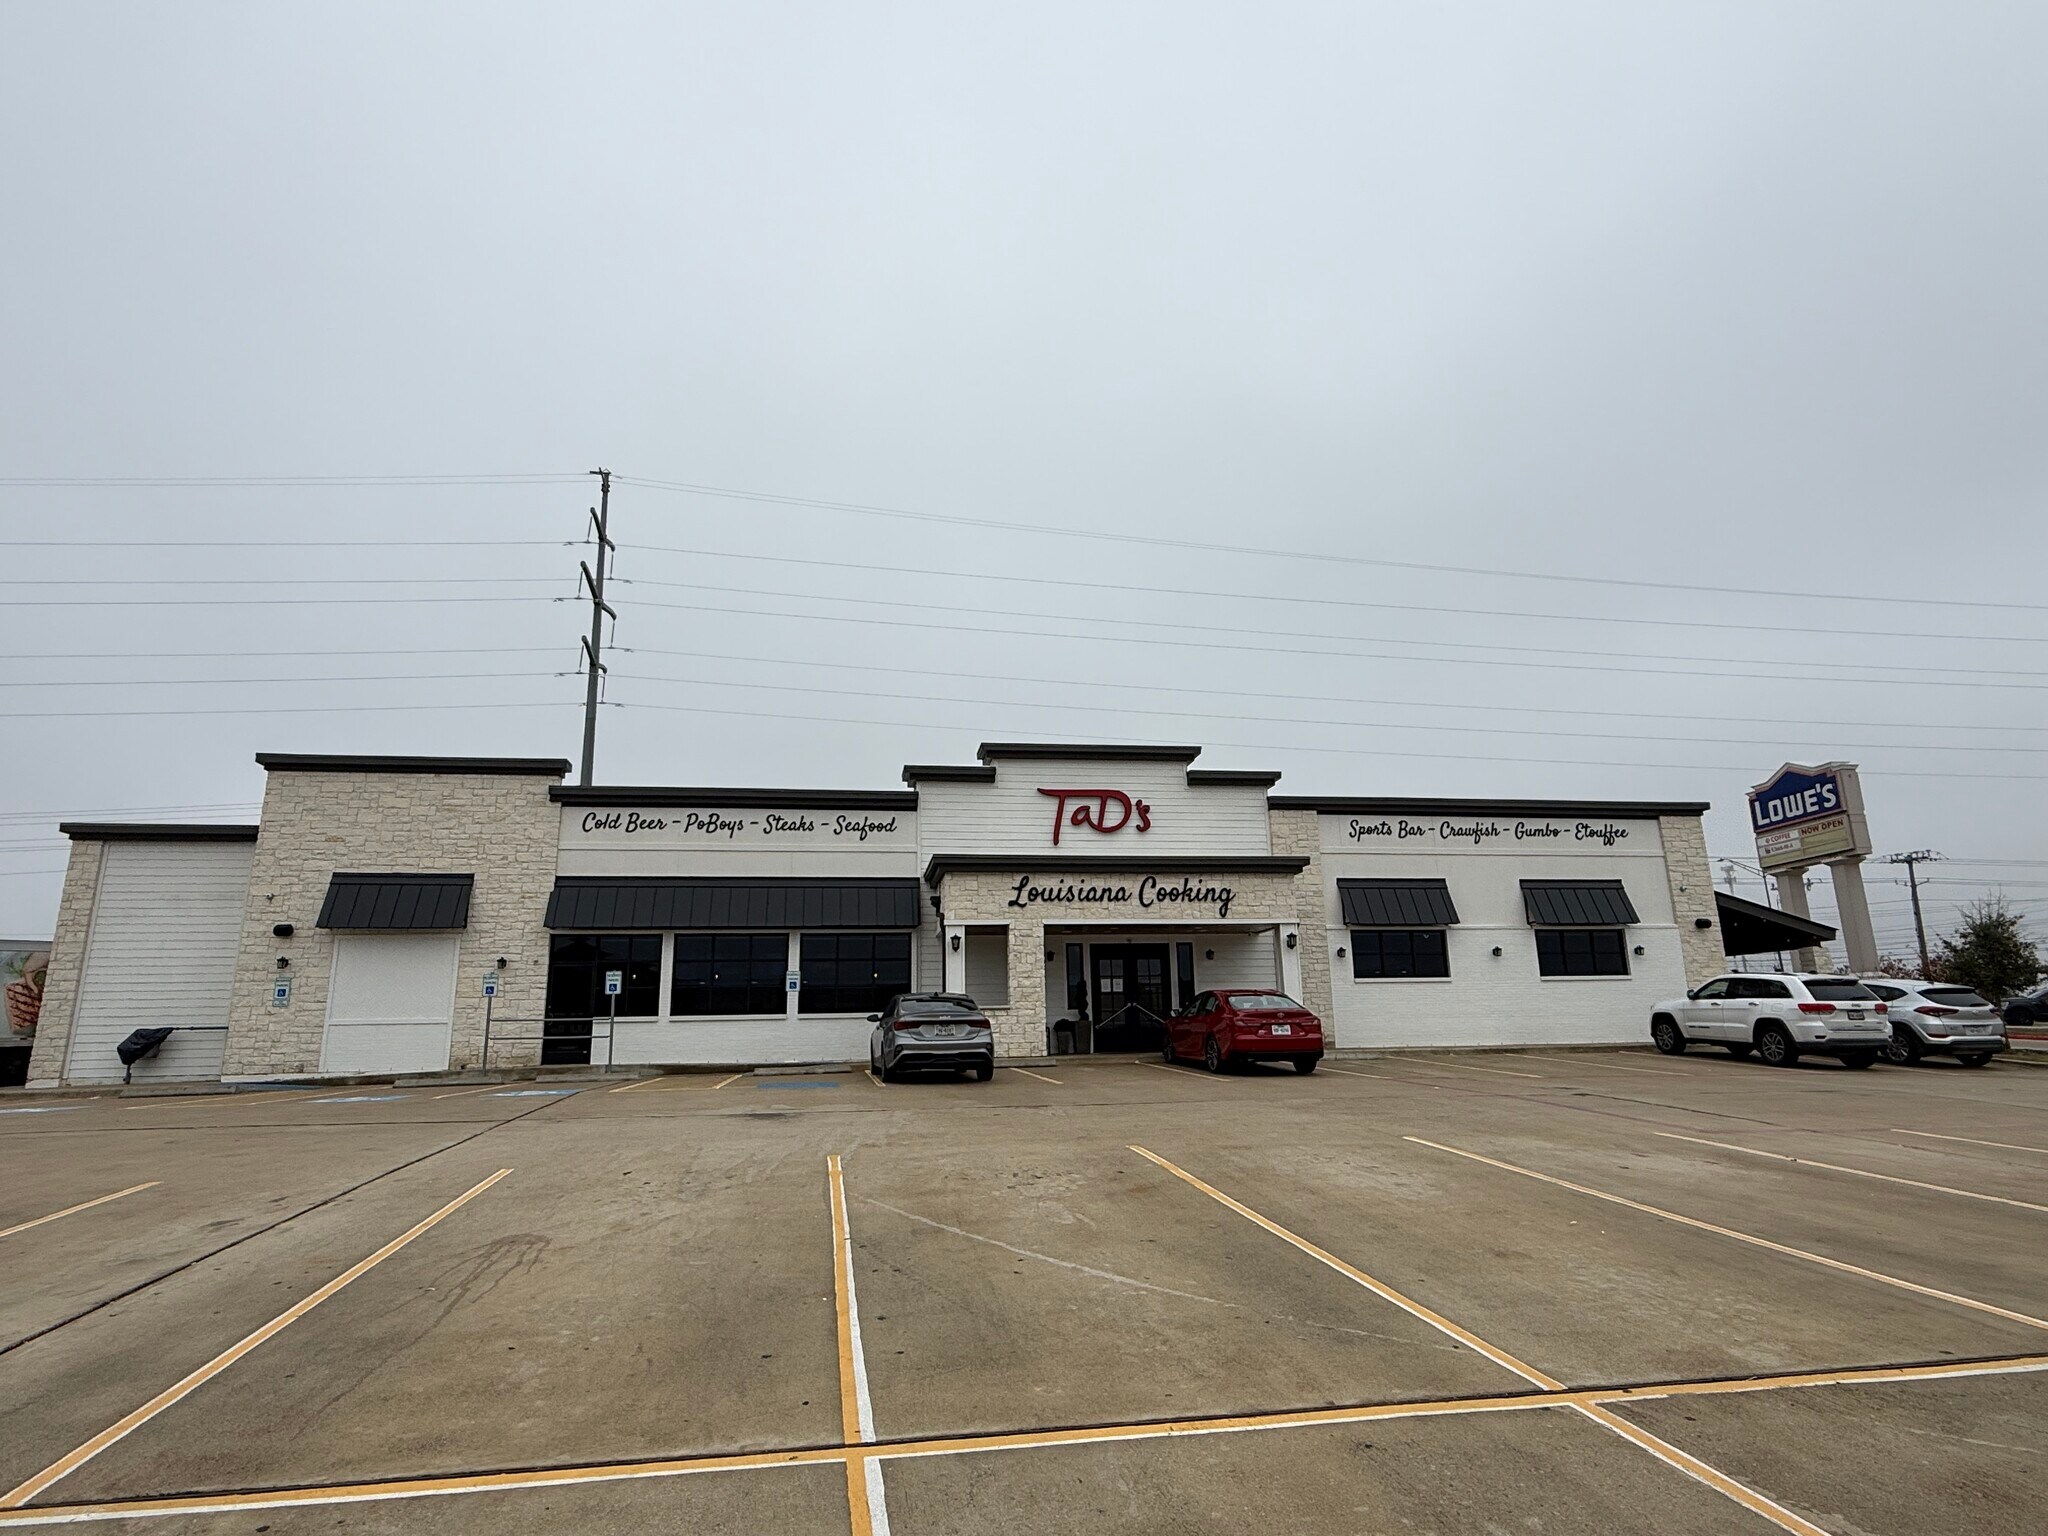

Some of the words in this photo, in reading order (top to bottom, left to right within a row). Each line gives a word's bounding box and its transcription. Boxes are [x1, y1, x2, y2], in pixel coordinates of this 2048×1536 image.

[1754, 783, 1837, 826] LOWE'S
[582, 811, 623, 832] Cold
[625, 811, 667, 834] Beer
[684, 812, 744, 839] PoBoys
[763, 813, 815, 835] Steaks
[833, 814, 897, 841] Seafood
[1348, 819, 1393, 842] Sports
[1397, 819, 1425, 839] Bar
[1439, 820, 1500, 844] Crawfish
[1514, 821, 1562, 840] Gumbo
[1574, 822, 1629, 846] Etouffee
[1801, 825, 1820, 836] NOW
[1821, 819, 1844, 830] OPEN
[1008, 875, 1132, 908] Louisiana
[1138, 875, 1236, 918] Cooking
